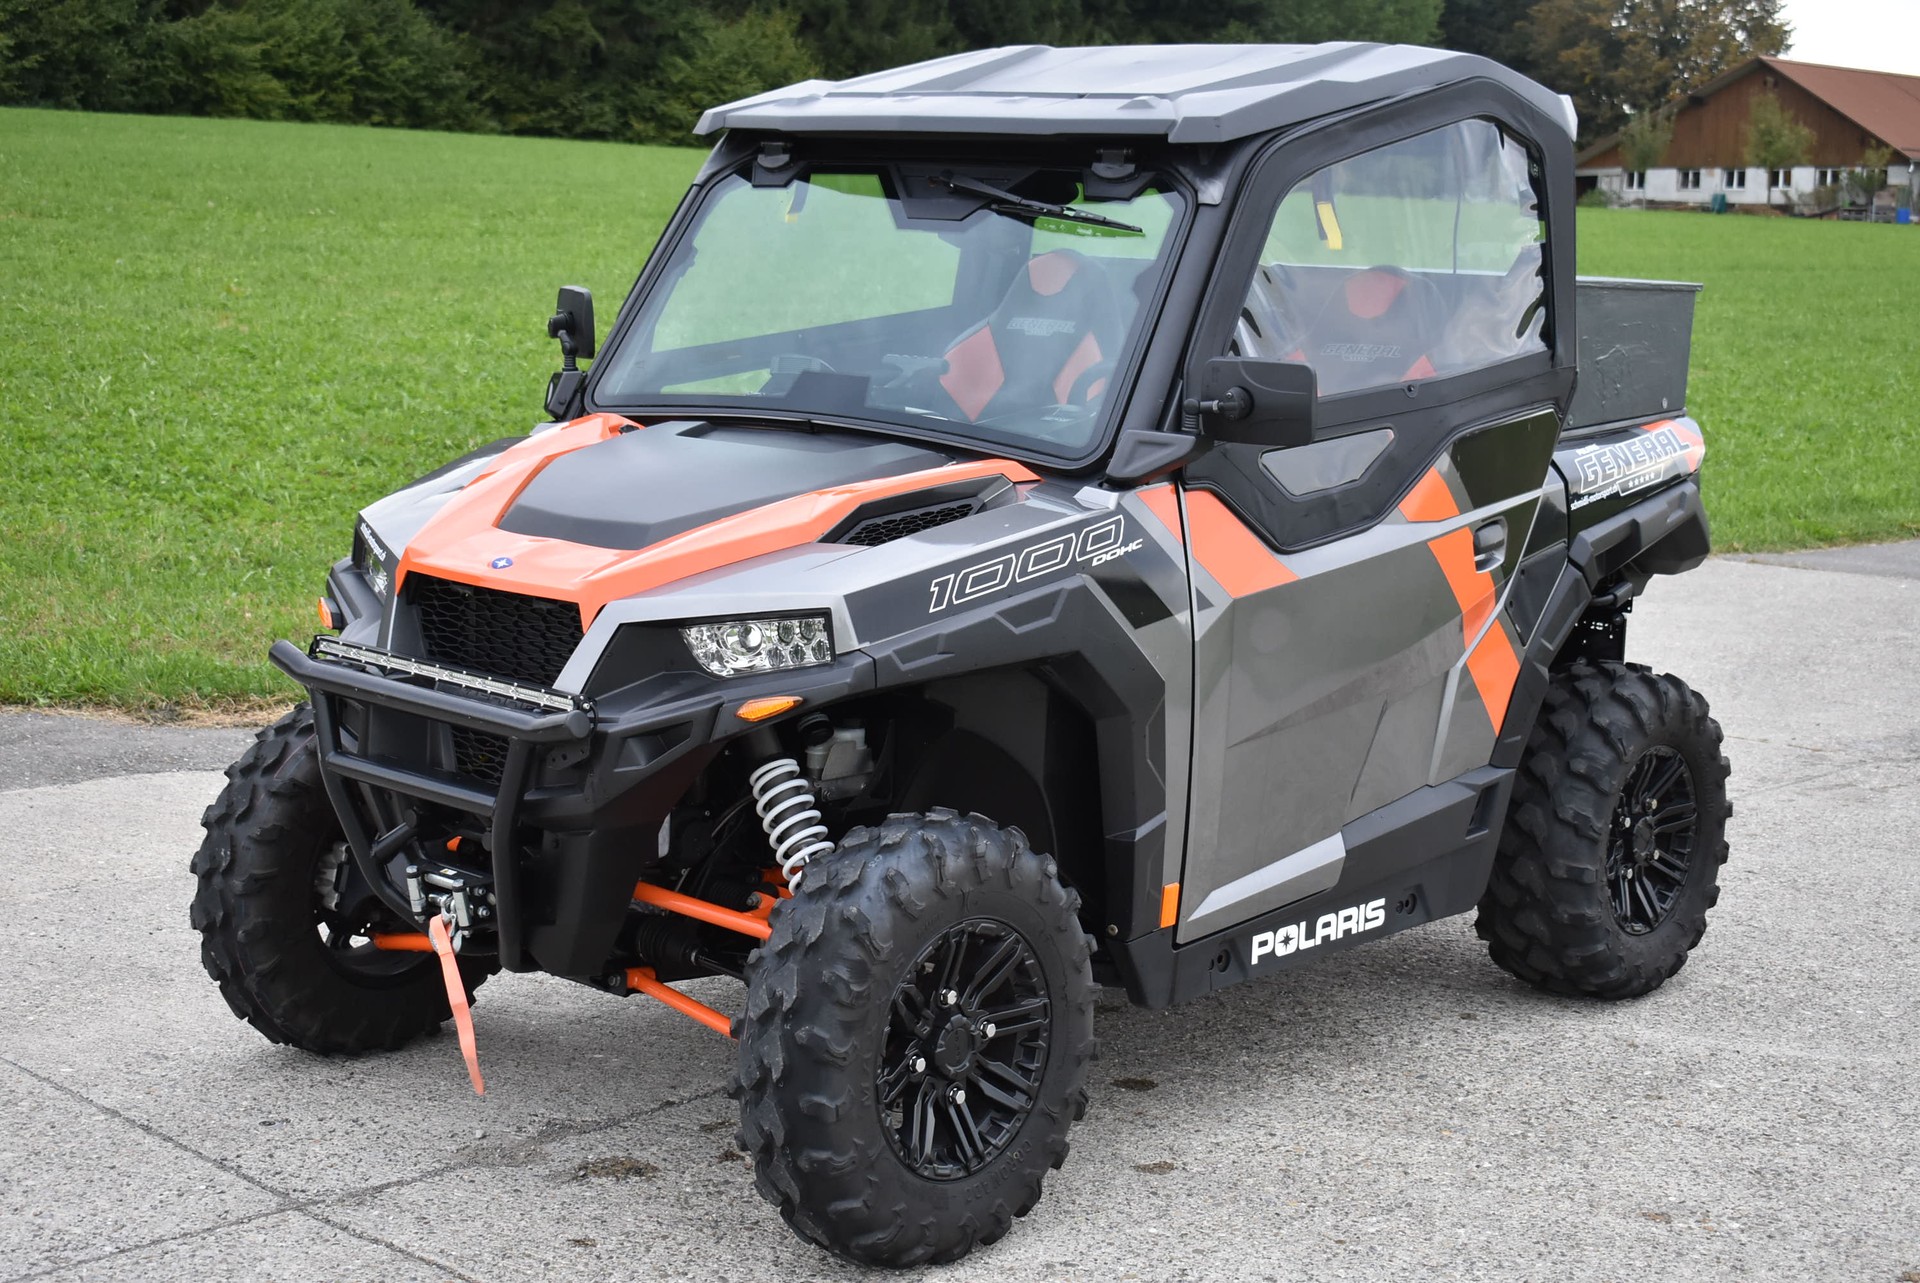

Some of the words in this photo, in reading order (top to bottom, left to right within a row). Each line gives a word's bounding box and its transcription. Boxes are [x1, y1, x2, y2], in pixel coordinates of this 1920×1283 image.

[1006, 317, 1076, 334] GENERAL
[1320, 342, 1402, 359] GENERAL
[1575, 427, 1692, 493] GENERAL
[929, 514, 1125, 614] 1000
[1092, 538, 1144, 567] DOHC
[1251, 897, 1386, 966] POLARIS
